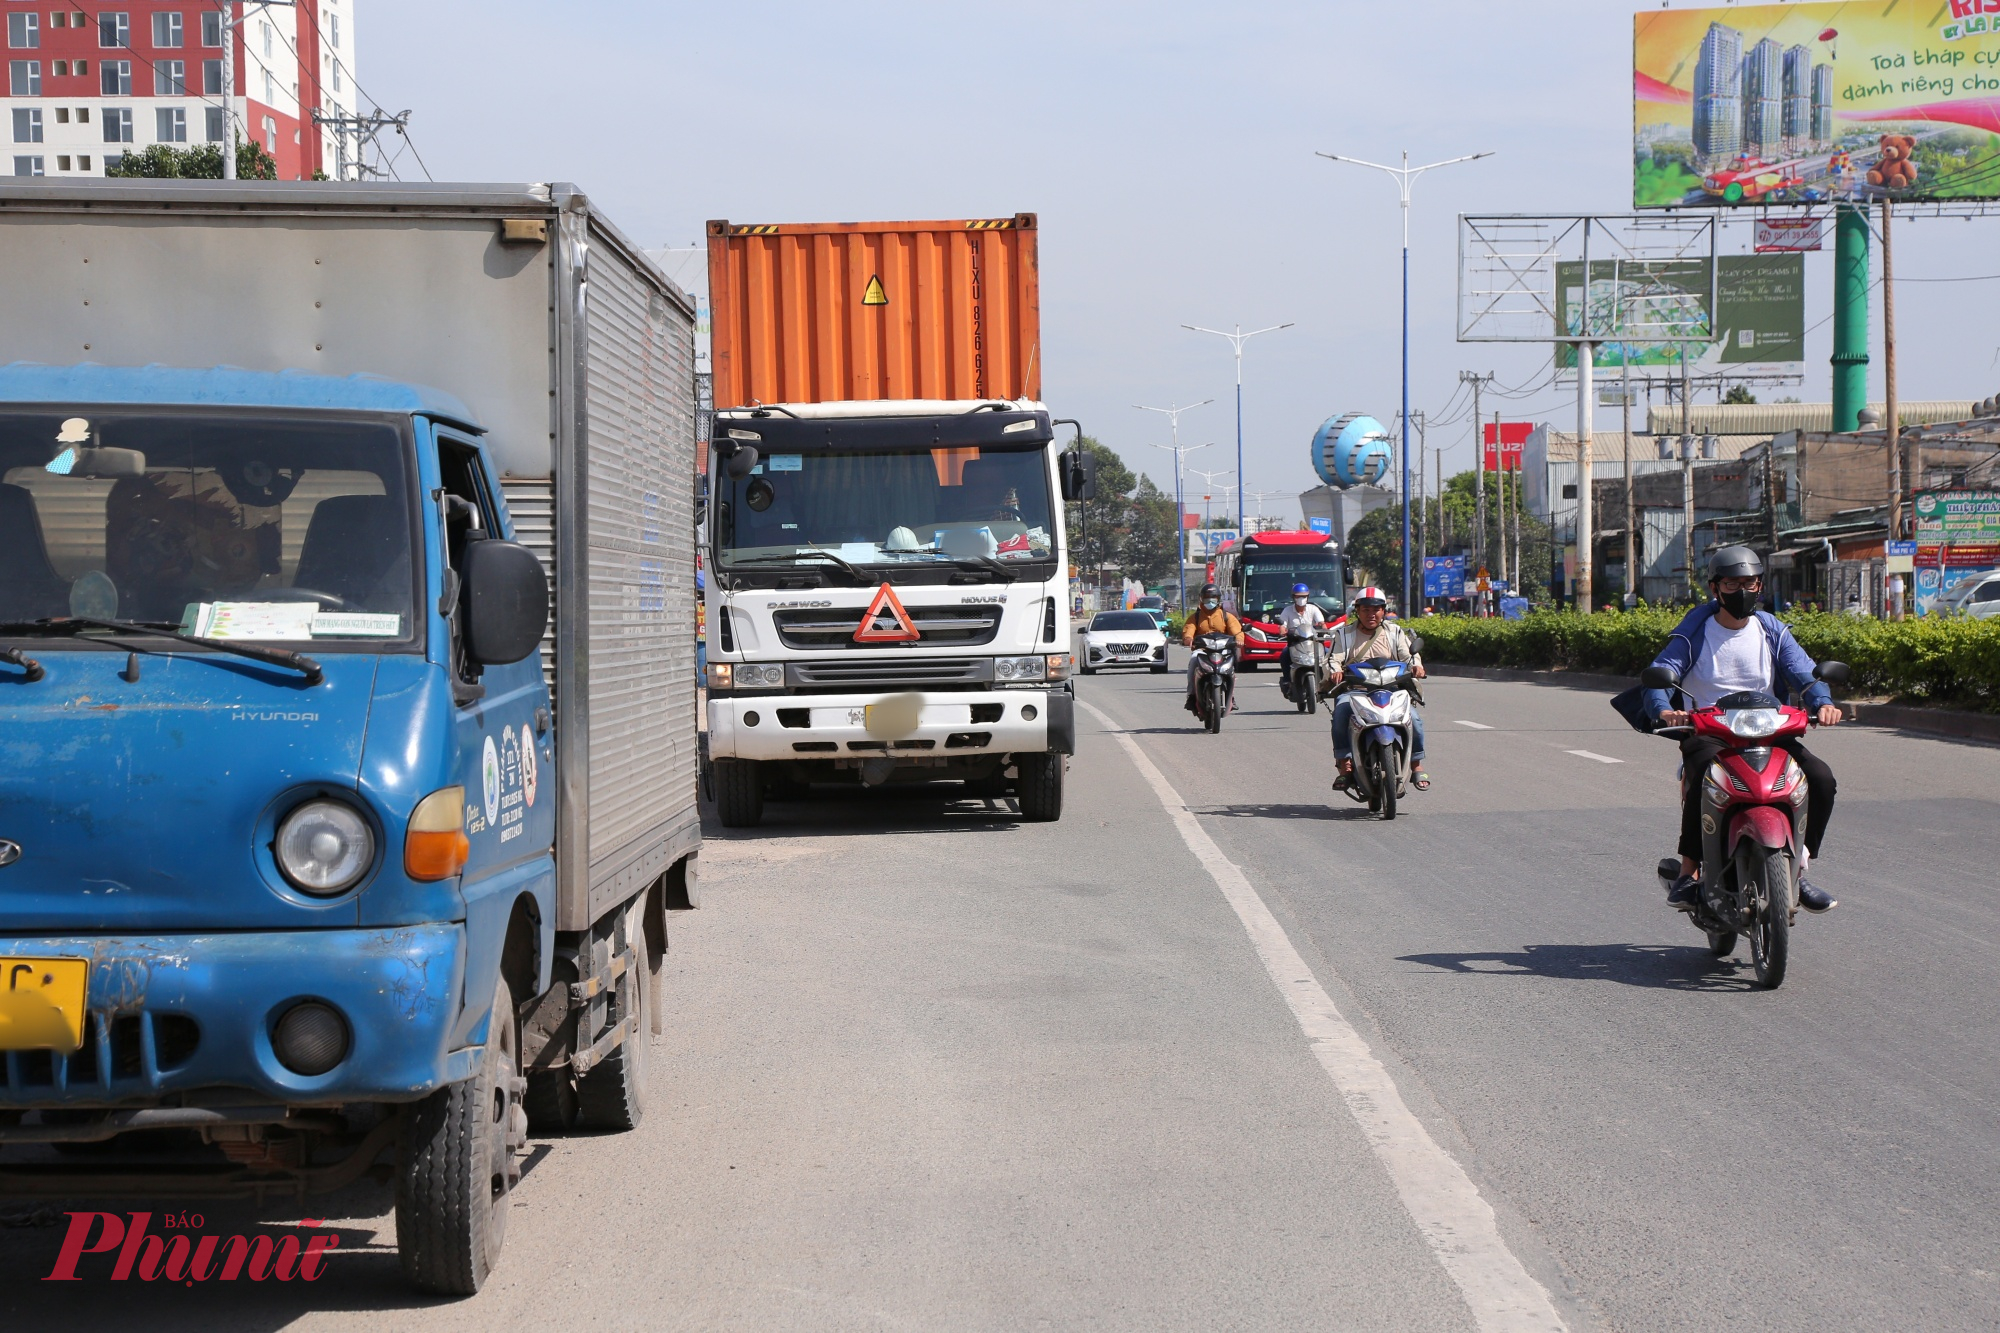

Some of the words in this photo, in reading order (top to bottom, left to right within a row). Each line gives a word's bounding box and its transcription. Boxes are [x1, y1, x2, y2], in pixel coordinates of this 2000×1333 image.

[1943, 25, 1959, 39] BY
[1965, 16, 1987, 33] LA
[1870, 53, 1906, 70] Toà
[1913, 48, 1965, 67] tháp
[1842, 79, 1894, 101] dành
[1901, 75, 1954, 96] riêng
[1962, 74, 2000, 90] cho
[971, 240, 980, 299] HLXU
[767, 600, 832, 609] DAEWOO
[961, 596, 998, 604] NOVUS
[232, 712, 319, 721] HYUNDAI
